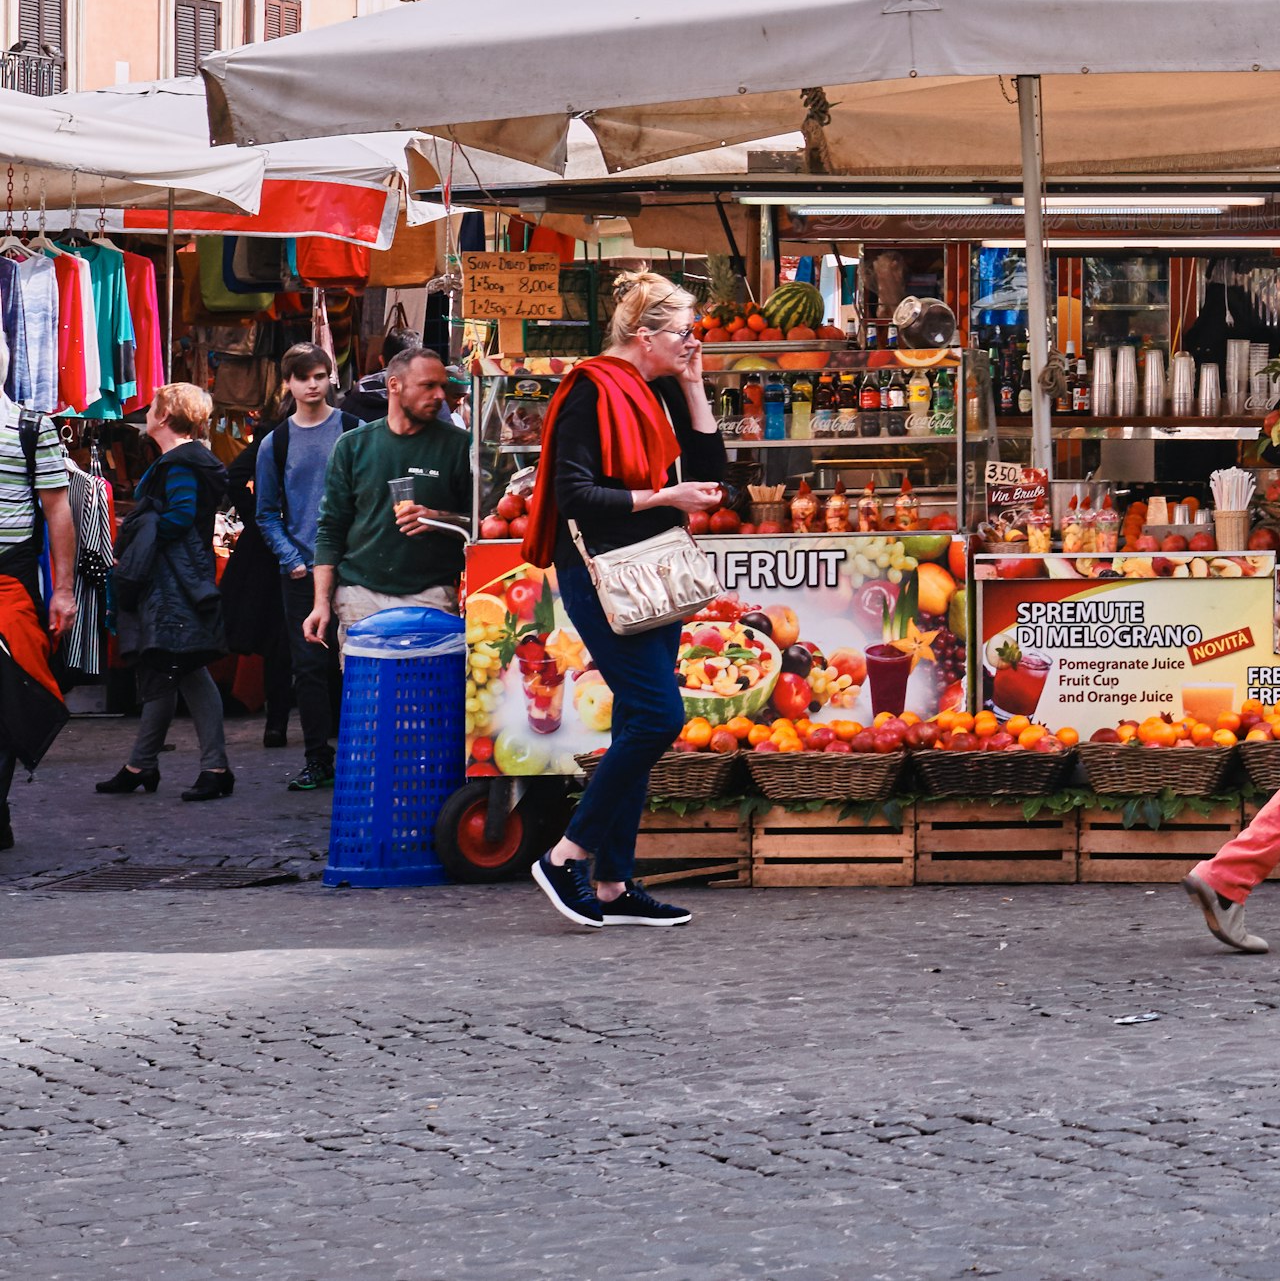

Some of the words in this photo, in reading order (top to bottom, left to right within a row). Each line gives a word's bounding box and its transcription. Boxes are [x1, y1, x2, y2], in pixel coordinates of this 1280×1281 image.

[991, 490, 1010, 503] Vin
[725, 549, 847, 590] FRUIT
[1016, 600, 1145, 624] SPREMUTE
[1016, 625, 1042, 649] DI
[1046, 624, 1203, 649] MELOGRANO
[1191, 629, 1250, 661] NOVITÀ
[1058, 658, 1149, 673] Pomegranate
[1151, 658, 1185, 670] Juice
[1058, 675, 1091, 687] Fruit
[1093, 675, 1120, 689] Cup
[1058, 691, 1085, 703] and
[1087, 691, 1137, 705] Orange
[1140, 691, 1174, 703] Juice
